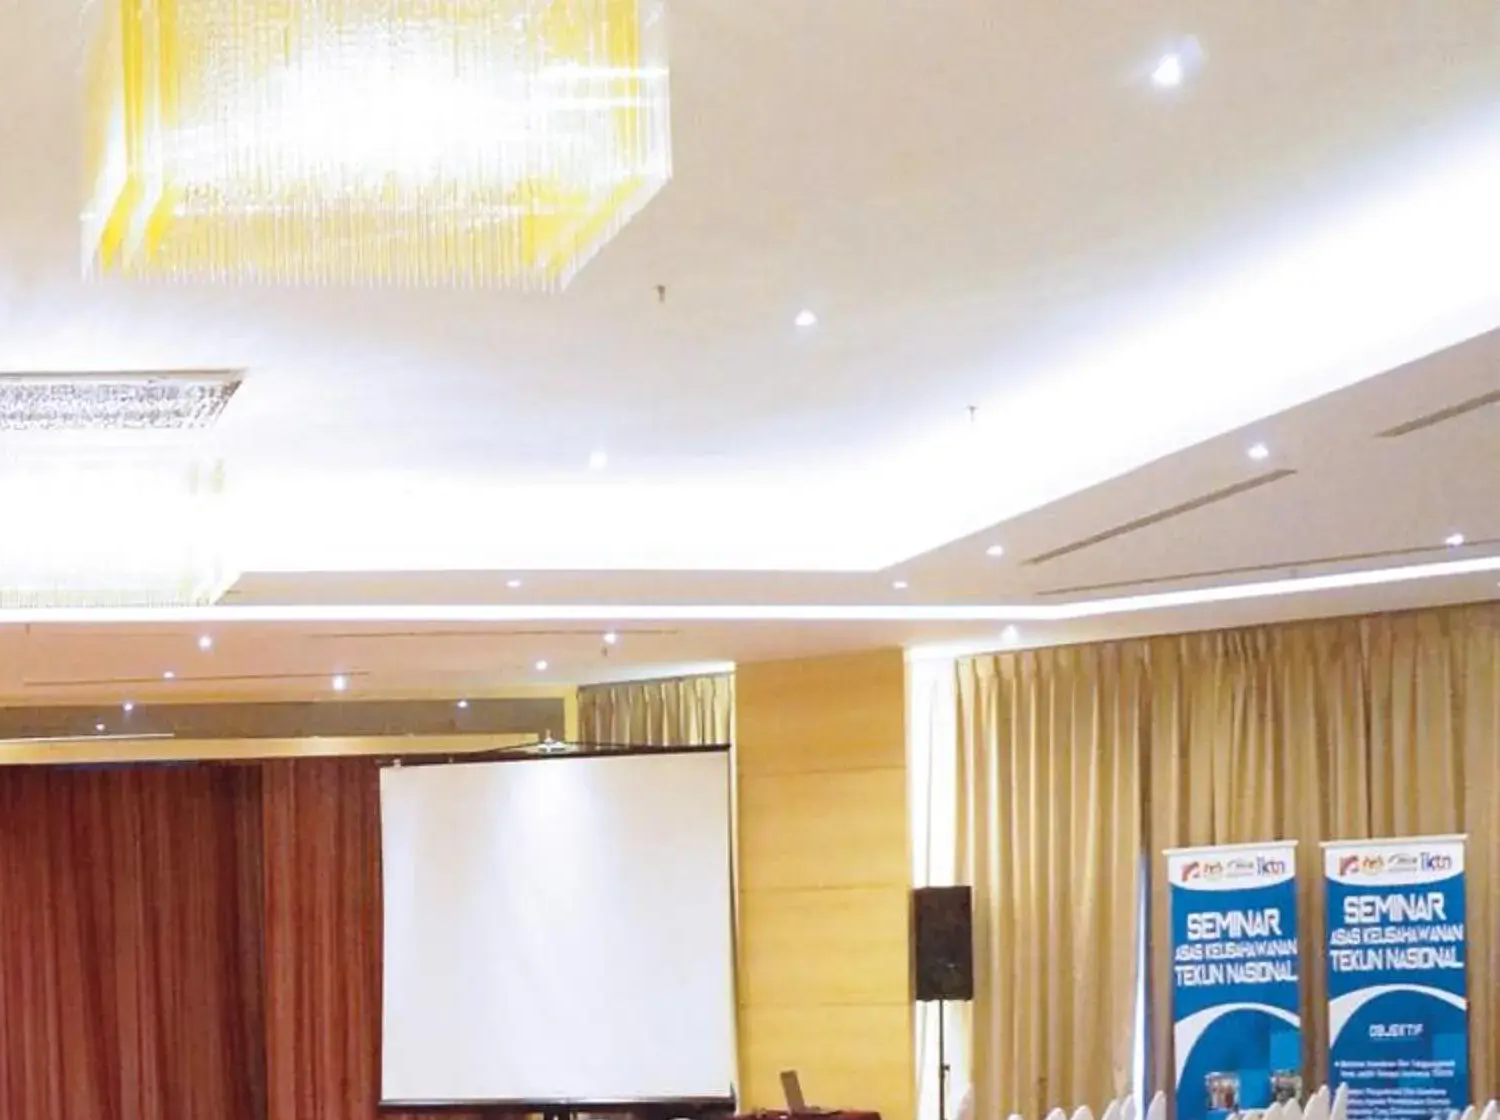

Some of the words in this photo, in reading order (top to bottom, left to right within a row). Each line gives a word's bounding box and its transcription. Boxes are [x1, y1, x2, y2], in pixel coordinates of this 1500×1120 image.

[1343, 891, 1447, 924] SEMINAR
[1187, 908, 1282, 940] SEMINAR
[1174, 963, 1224, 987] TEKUN
[1227, 960, 1298, 984] NASIONAL
[1329, 949, 1383, 972] TEKUN
[1385, 946, 1464, 969] NASIONAL
